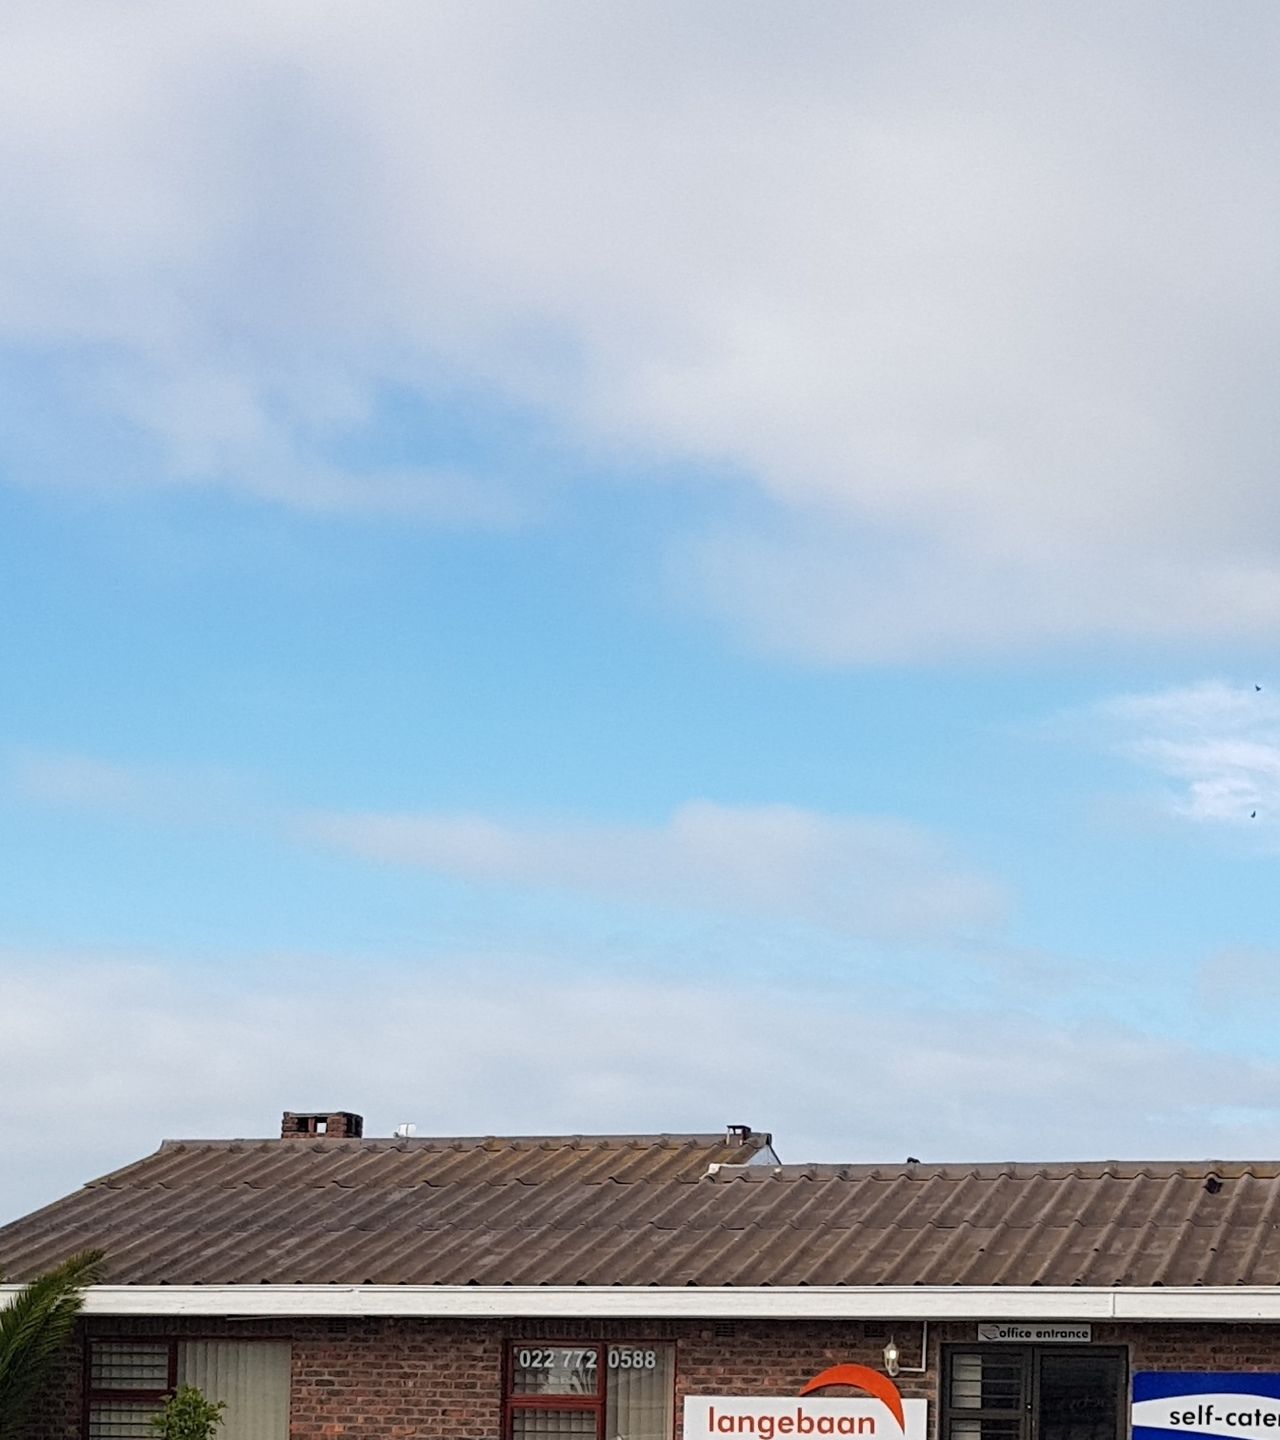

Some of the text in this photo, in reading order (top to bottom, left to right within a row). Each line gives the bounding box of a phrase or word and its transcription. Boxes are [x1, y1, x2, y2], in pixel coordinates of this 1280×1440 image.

[999, 1327, 1089, 1339] office entrance
[520, 1350, 656, 1369] 022 772 0588
[708, 1406, 876, 1440] langebaan
